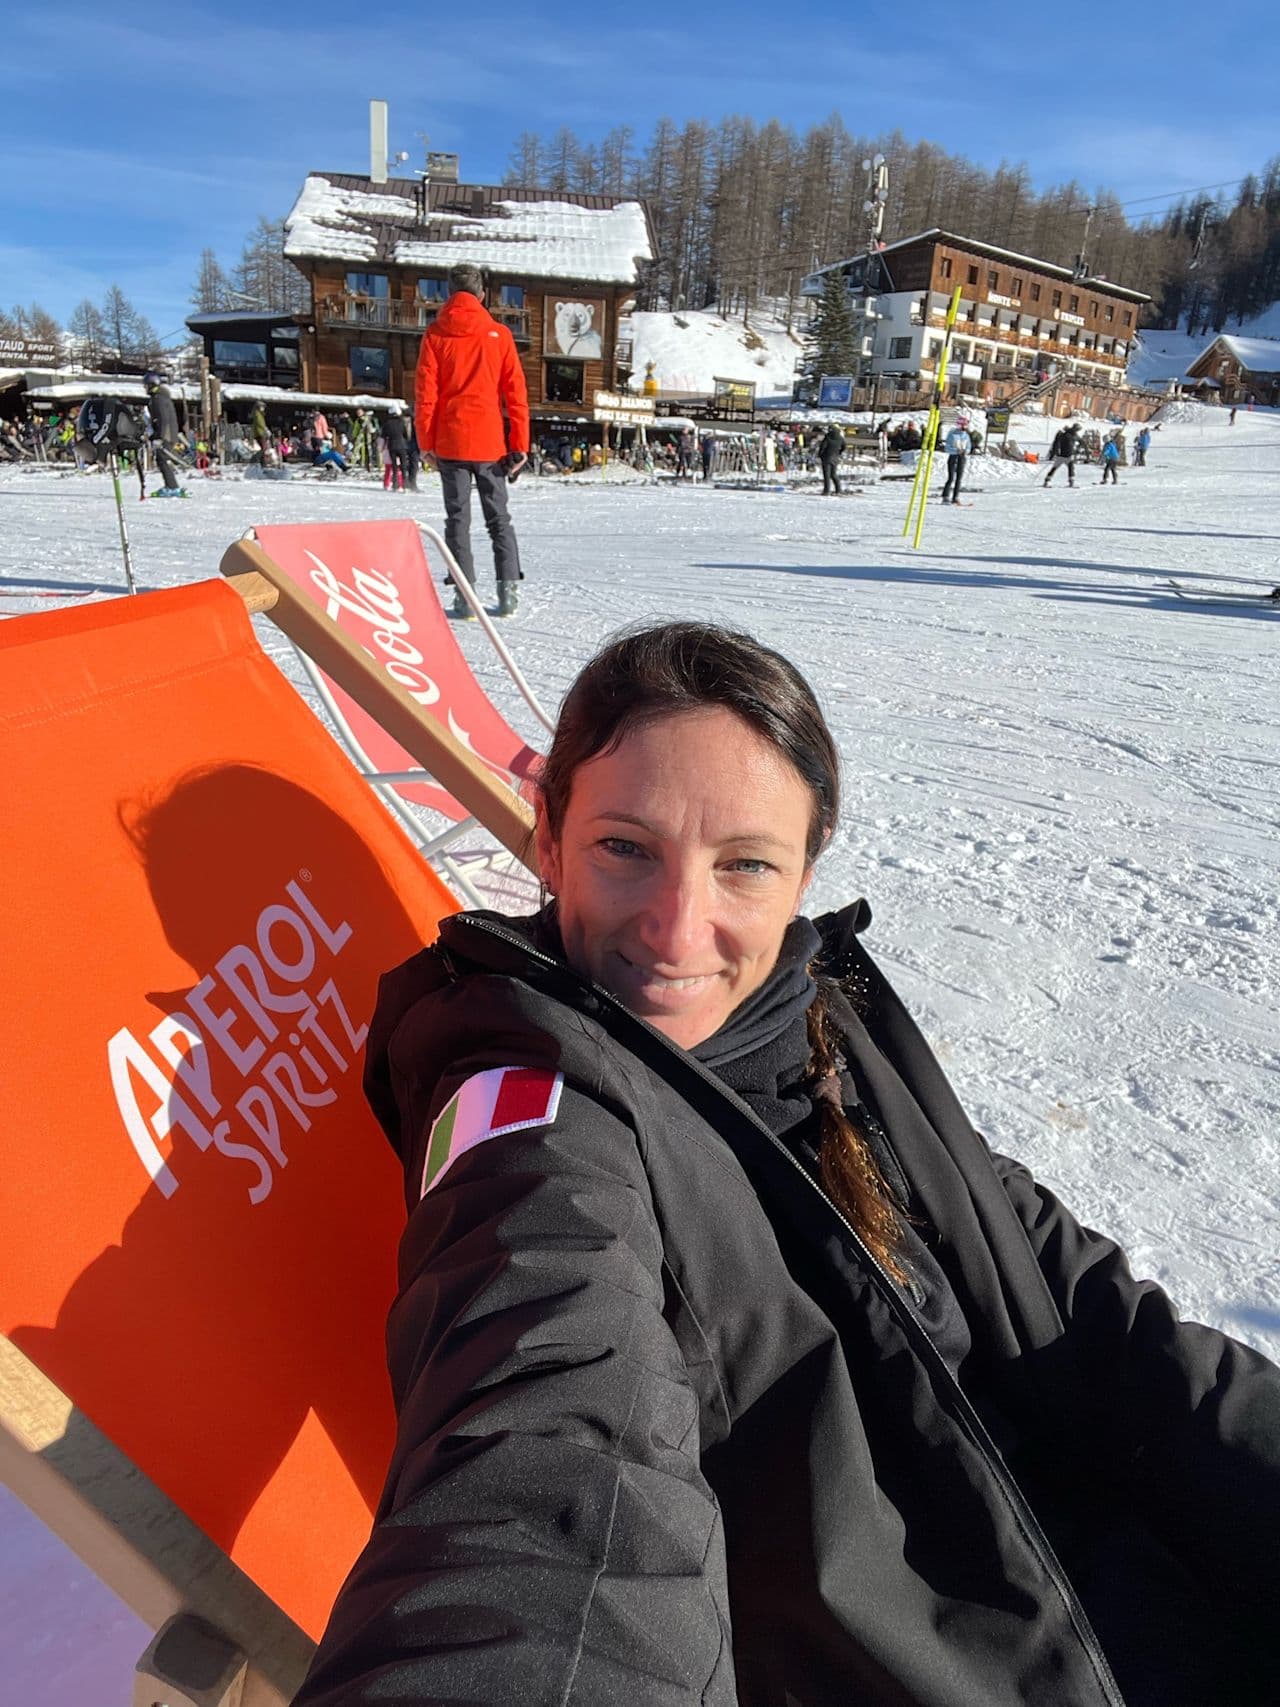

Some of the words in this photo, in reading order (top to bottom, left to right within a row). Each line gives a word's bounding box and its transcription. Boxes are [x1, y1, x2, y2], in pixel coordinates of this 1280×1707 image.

[27, 343, 55, 353] SPORT
[32, 354, 56, 362] SHOP
[550, 424, 579, 432] HOTEL
[107, 879, 353, 1200] APEROL
